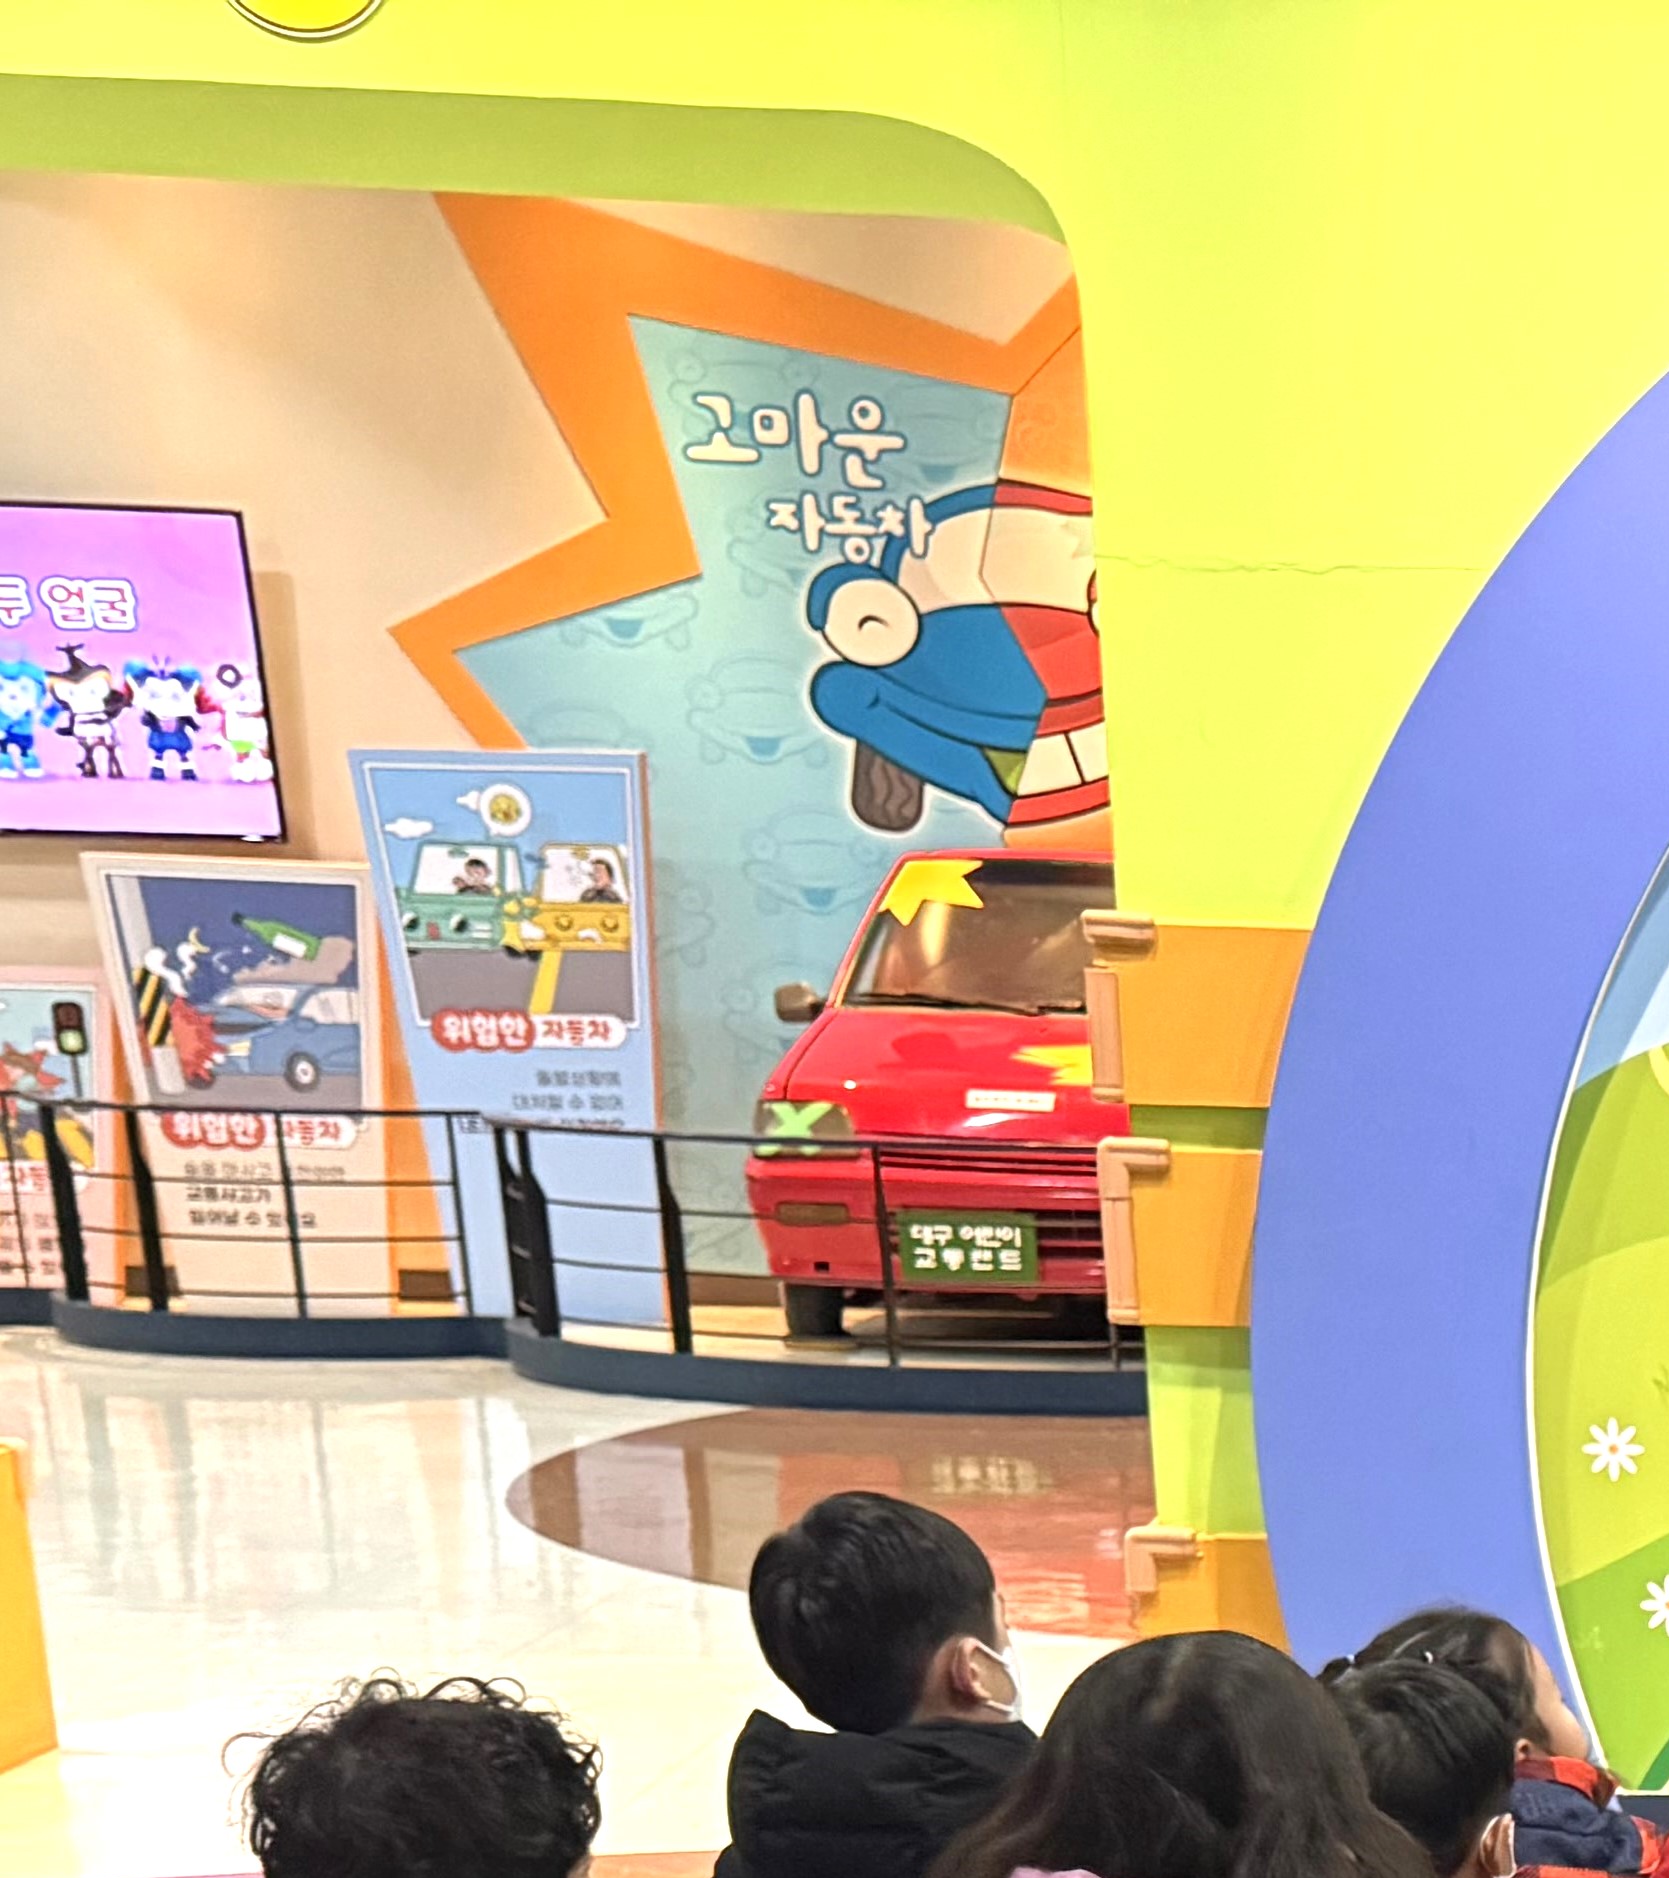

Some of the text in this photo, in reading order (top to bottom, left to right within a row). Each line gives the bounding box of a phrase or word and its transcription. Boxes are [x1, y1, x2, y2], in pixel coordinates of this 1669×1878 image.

[686, 389, 905, 489] 고마운
[768, 493, 935, 564] 자동차
[43, 580, 132, 628] 얼굴
[442, 1013, 611, 1047] 위험한 자동차
[910, 1223, 1022, 1248] 대구 어린이
